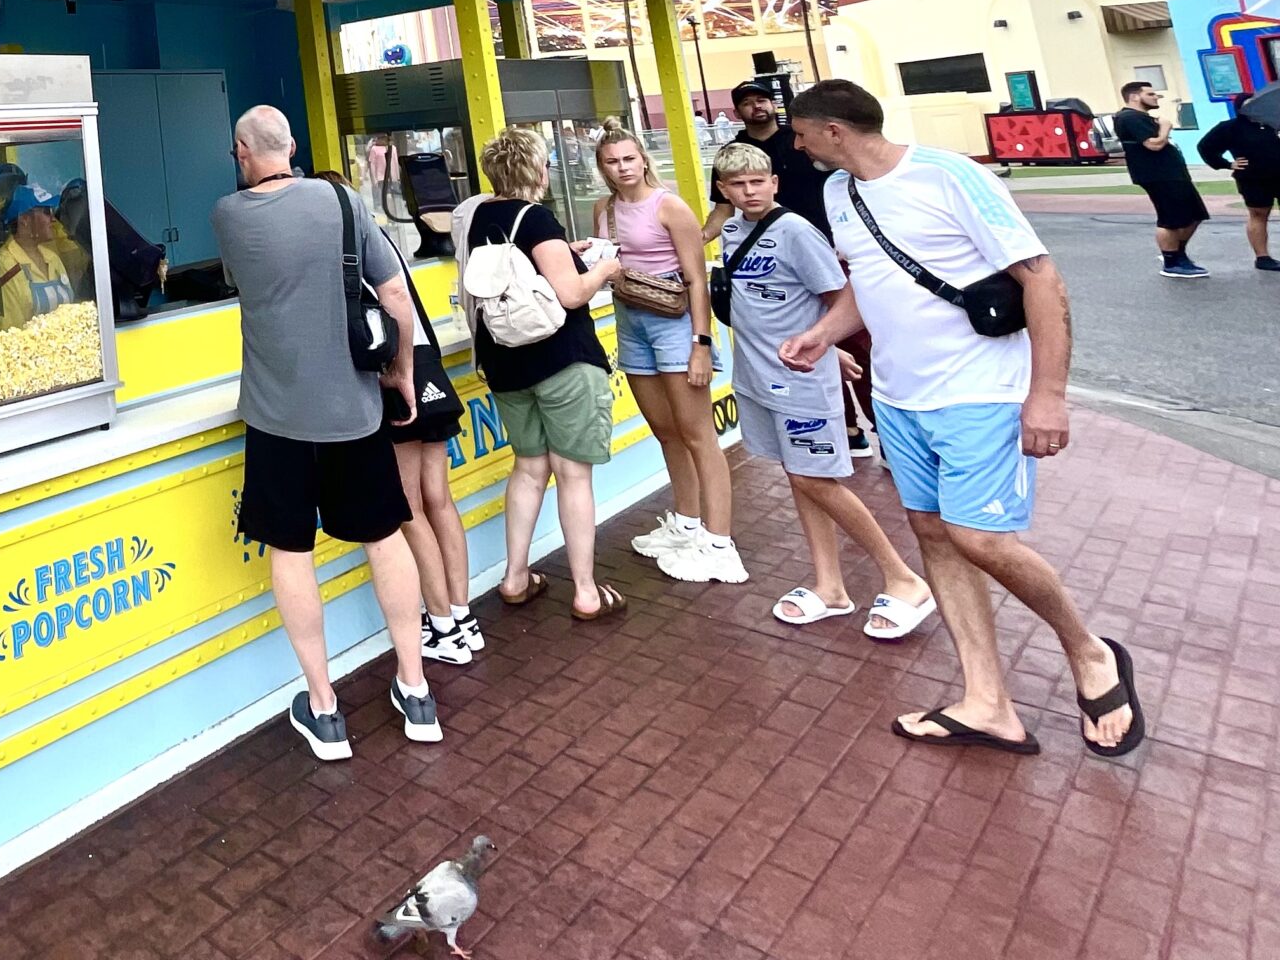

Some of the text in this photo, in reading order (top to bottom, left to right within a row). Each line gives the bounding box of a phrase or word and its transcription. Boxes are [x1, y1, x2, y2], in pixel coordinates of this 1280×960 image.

[875, 234, 923, 277] ARMOUR
[34, 537, 125, 604] FRESH
[11, 570, 152, 661] POPCORN
